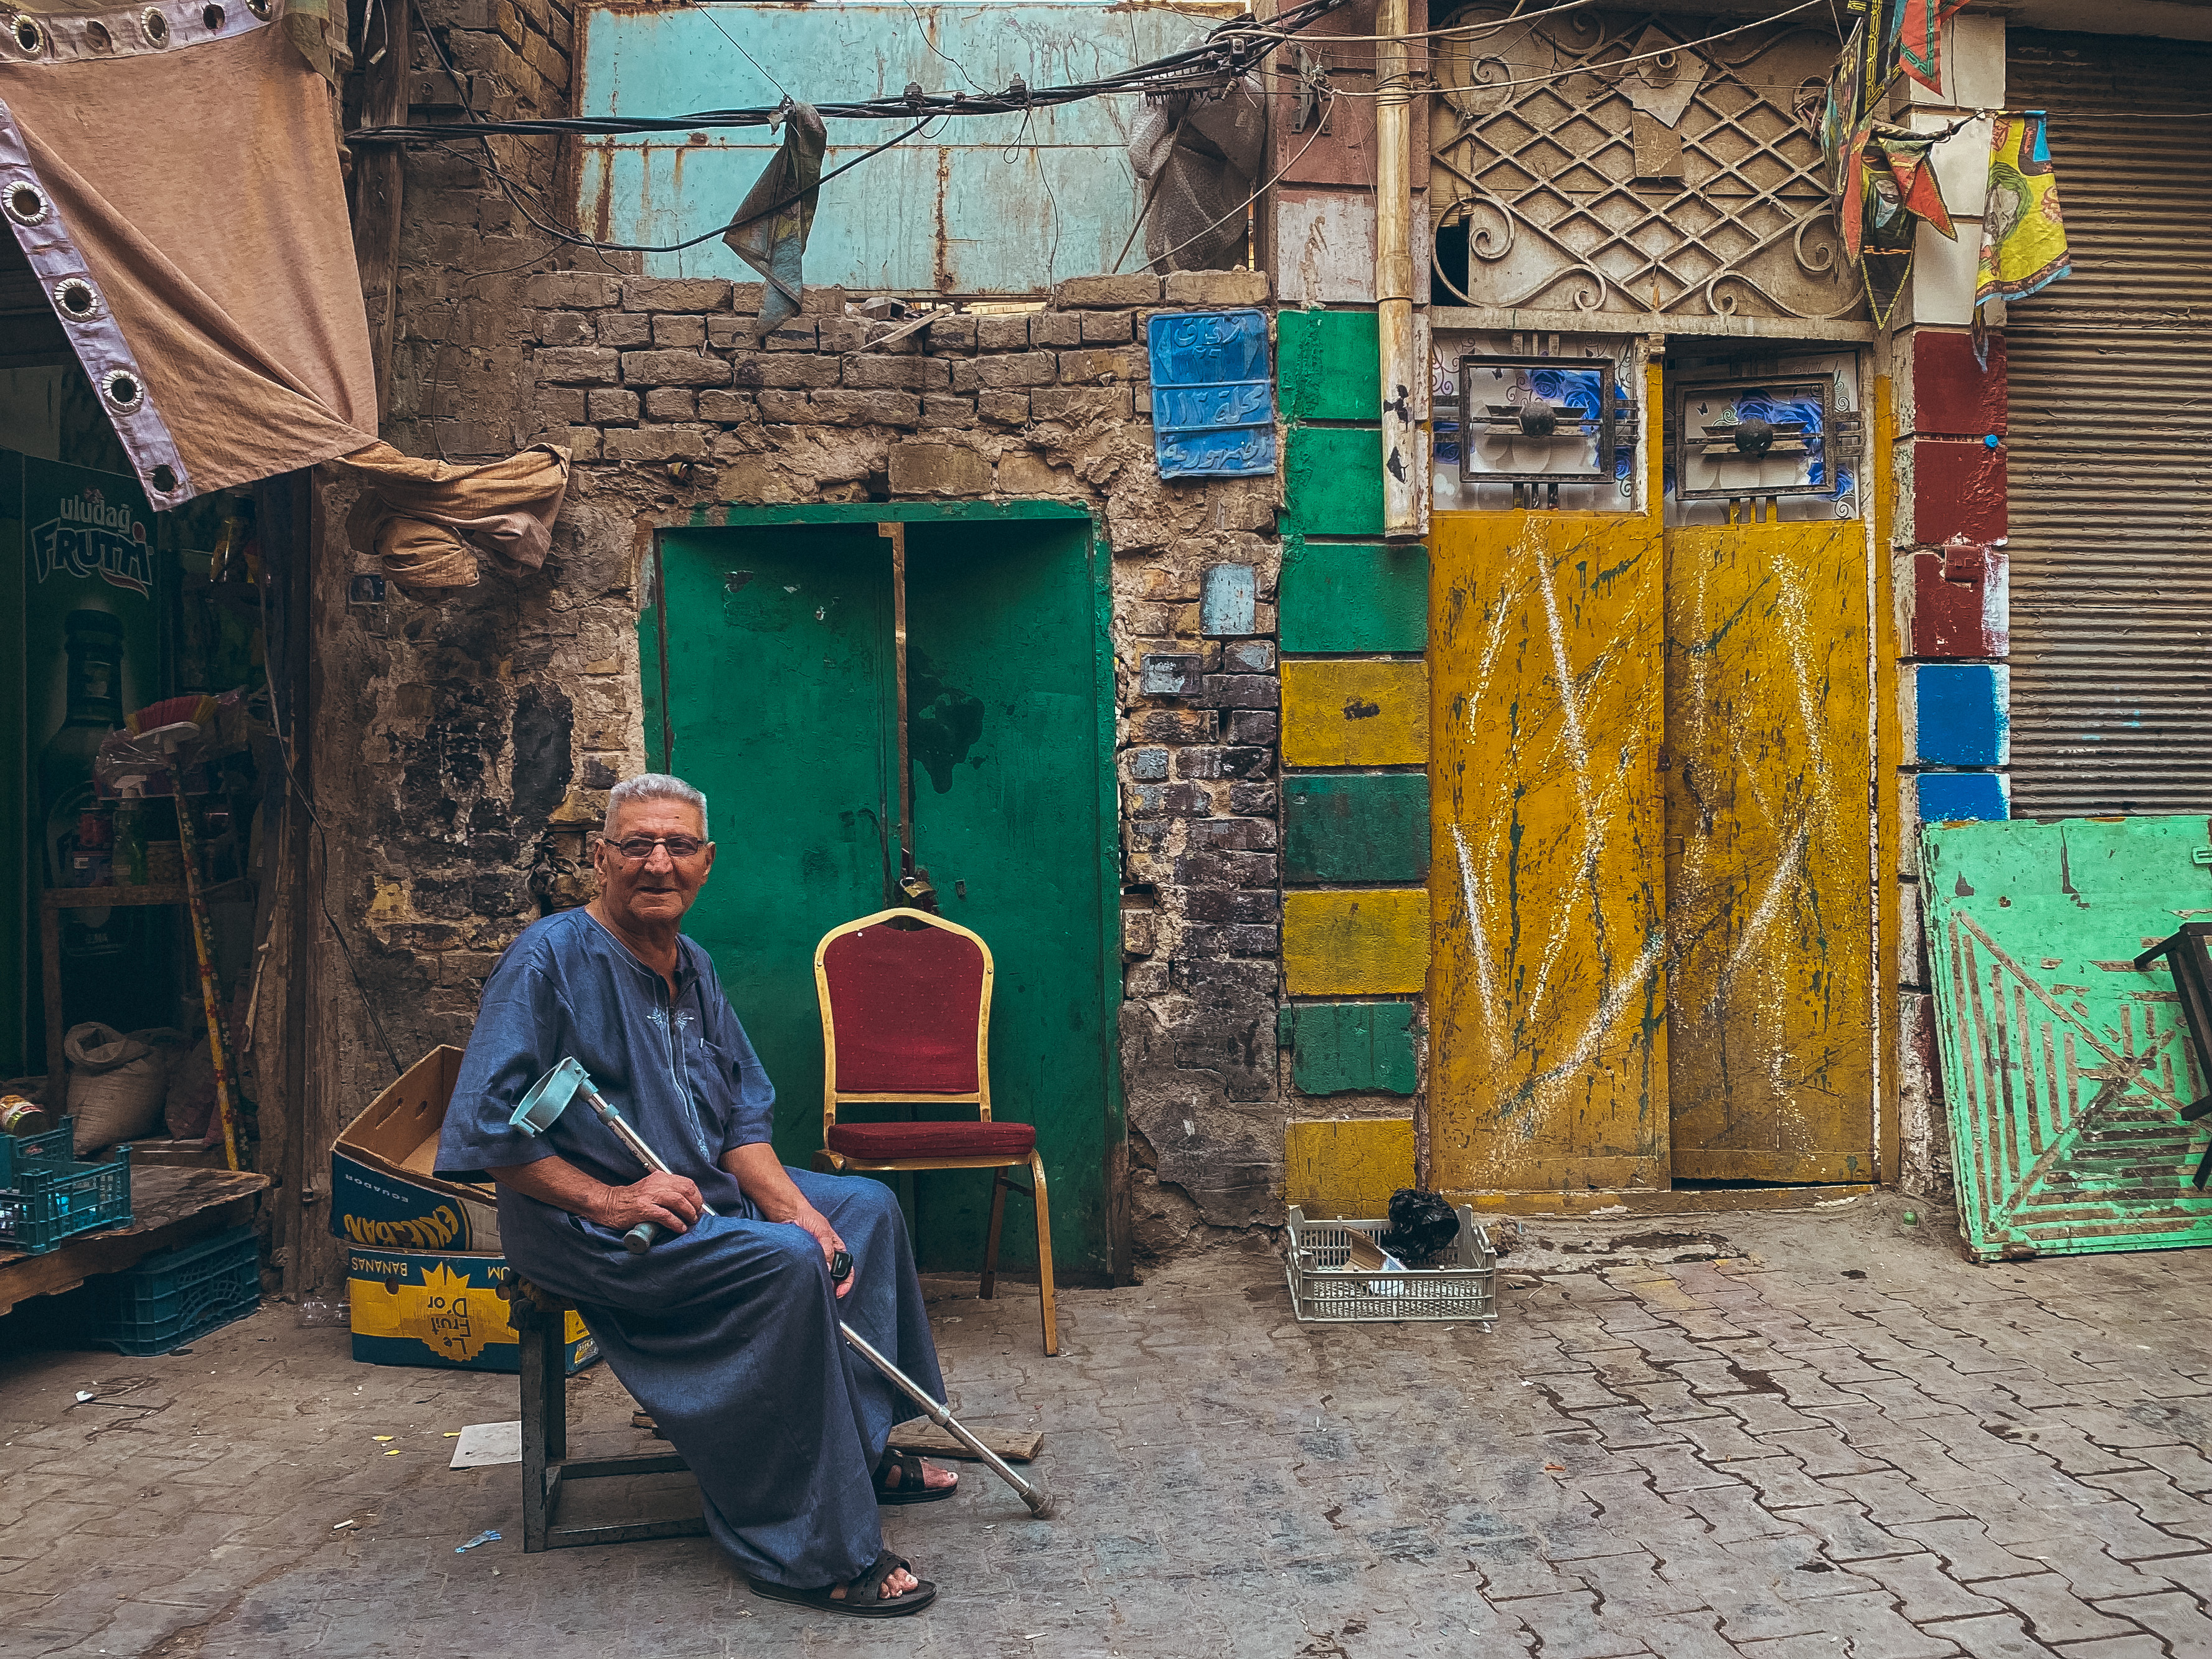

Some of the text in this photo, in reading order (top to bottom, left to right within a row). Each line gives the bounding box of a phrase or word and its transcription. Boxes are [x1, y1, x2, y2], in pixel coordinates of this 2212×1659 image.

[1174, 316, 1246, 348] زقاق
[1215, 385, 1264, 425] محلة
[1161, 429, 1270, 470] الجمهورية
[60, 494, 131, 535] uludağ
[345, 1173, 408, 1203] ECUADOR
[351, 1257, 408, 1277] BANANAS
[431, 1317, 471, 1338] Fruit
[443, 1337, 468, 1355] Le
